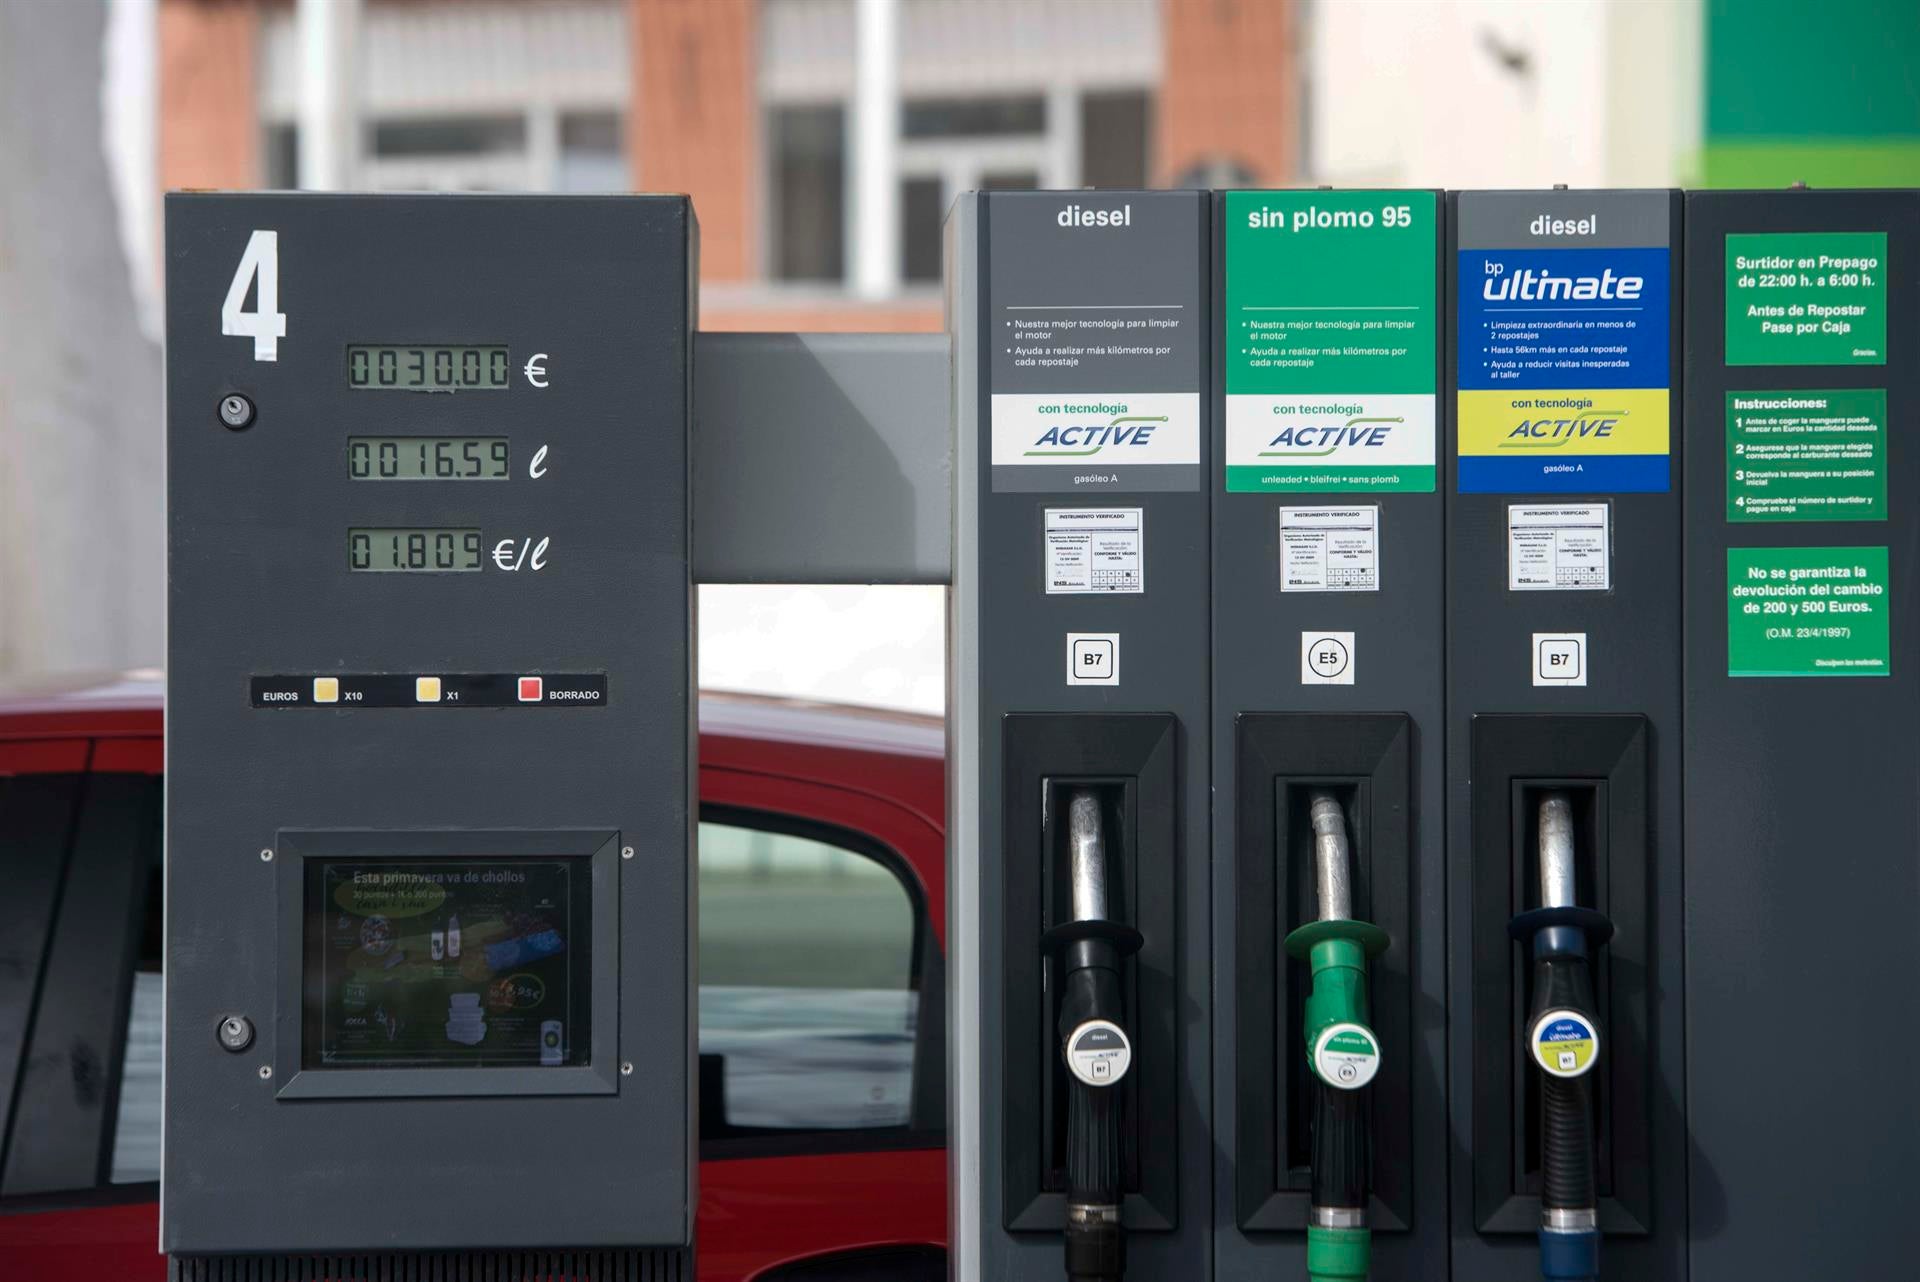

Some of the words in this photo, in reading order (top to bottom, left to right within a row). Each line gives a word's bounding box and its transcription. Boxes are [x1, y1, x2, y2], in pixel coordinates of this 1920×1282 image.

[1058, 205, 1130, 227] diesel
[1248, 206, 1284, 228] sin
[1293, 206, 1374, 232] plomo
[1382, 206, 1411, 227] 95
[1530, 214, 1596, 235] diesel
[1485, 260, 1504, 277] bp
[1736, 256, 1794, 269] Surtidor
[1798, 258, 1815, 268] en
[1819, 255, 1877, 271] Prepago
[1483, 268, 1643, 300] ultimate
[1738, 275, 1756, 288] de
[1759, 274, 1797, 287] 22:00
[1800, 274, 1813, 287] h.
[1817, 277, 1825, 287] a
[1828, 274, 1859, 287] 6:00
[1861, 274, 1875, 286] h.
[222, 230, 286, 362] 4
[1748, 305, 1785, 316] Antes
[1788, 305, 1804, 316] de
[1808, 304, 1866, 318] Repostar
[1015, 320, 1049, 328] Nuestra
[1052, 320, 1077, 330] mejor
[1079, 319, 1124, 329] tecnología
[1127, 321, 1146, 329] para
[1149, 319, 1179, 328] limpiar
[1250, 320, 1285, 329] Nuestra
[1287, 321, 1313, 330] mejor
[1315, 320, 1361, 330] tecnología
[1384, 321, 1415, 329] limpiar
[1491, 321, 1526, 330] Limpieza
[1527, 321, 1583, 329] extraordinaria
[1625, 320, 1636, 328] de
[1762, 321, 1793, 333] Pase
[1796, 324, 1819, 335] por
[1821, 321, 1850, 335] Caja
[1015, 331, 1023, 339] el
[1250, 332, 1258, 340] el
[1498, 332, 1539, 340] repostajes
[1015, 346, 1043, 356] Ayuda
[1053, 346, 1084, 355] realizar
[1087, 346, 1105, 354] más
[1107, 346, 1153, 354] kilómetros
[1156, 347, 1171, 355] por
[1250, 347, 1279, 357] Ayuda
[1288, 347, 1320, 356] realizar
[1322, 347, 1341, 355] más
[1343, 347, 1390, 355] kilómetros
[1491, 346, 1513, 354] Hasta
[1515, 346, 1537, 354] 56km
[1569, 345, 1589, 353] cada
[1590, 346, 1627, 354] repostaje
[351, 350, 508, 386] 0030.00
[1015, 358, 1036, 366] cada
[1038, 358, 1079, 367] repostaje
[1250, 358, 1271, 367] cada
[1273, 359, 1314, 368] repostaje
[1491, 360, 1516, 369] Ayuda
[1525, 360, 1552, 368] reducir
[1555, 360, 1580, 368] visitas
[1582, 360, 1630, 369] inesperadas
[524, 353, 549, 387] €
[1038, 406, 1060, 414] con
[1064, 402, 1128, 415] tecnología
[1273, 406, 1296, 414] con
[1299, 403, 1363, 416] tecnología
[1512, 400, 1532, 408] con
[1535, 398, 1592, 410] tecnología
[1734, 398, 1826, 409] Instrucciones:
[1508, 420, 1617, 438] ACTIVE
[1736, 418, 1742, 428] 1
[1783, 424, 1805, 432] Euros
[1035, 426, 1156, 446] ACTIVE
[1269, 427, 1391, 446] ACTIVE
[351, 442, 508, 477] 0016.59
[1544, 464, 1575, 474] gasóleo
[1576, 464, 1583, 472] A
[1736, 470, 1744, 480] 3
[1788, 471, 1825, 479] manguera
[1843, 470, 1874, 478] posición
[1074, 474, 1108, 484] gasóleo
[1111, 474, 1118, 482] A
[1310, 475, 1341, 483] bleifrei
[1348, 476, 1369, 485] sans
[1371, 475, 1400, 485] plomb
[351, 533, 481, 569] 01.809
[1748, 567, 1767, 579] No
[1770, 569, 1786, 579] se
[1789, 567, 1851, 581] garantiza
[1854, 566, 1866, 577] la
[1733, 584, 1806, 596] devolución
[1809, 584, 1830, 595] del
[1833, 583, 1882, 595] cambio
[1743, 602, 1760, 613] de
[1763, 601, 1787, 613] 200
[1790, 604, 1798, 615] y
[1802, 601, 1825, 613] 500
[1829, 601, 1872, 612] Euros.
[1766, 628, 1793, 639] (O.M.
[1796, 627, 1851, 638] 23/4/1997)
[1084, 653, 1103, 665] B7
[1319, 652, 1337, 664] E5
[1551, 654, 1569, 665] B7
[263, 692, 298, 701] EUROS
[345, 692, 363, 701] X10
[447, 692, 458, 700] X1
[550, 691, 599, 699] BORRADO
[353, 871, 380, 884] Esta
[383, 872, 444, 886] primavera
[447, 874, 460, 883] va
[464, 871, 479, 883] de
[482, 870, 525, 883] chollos
